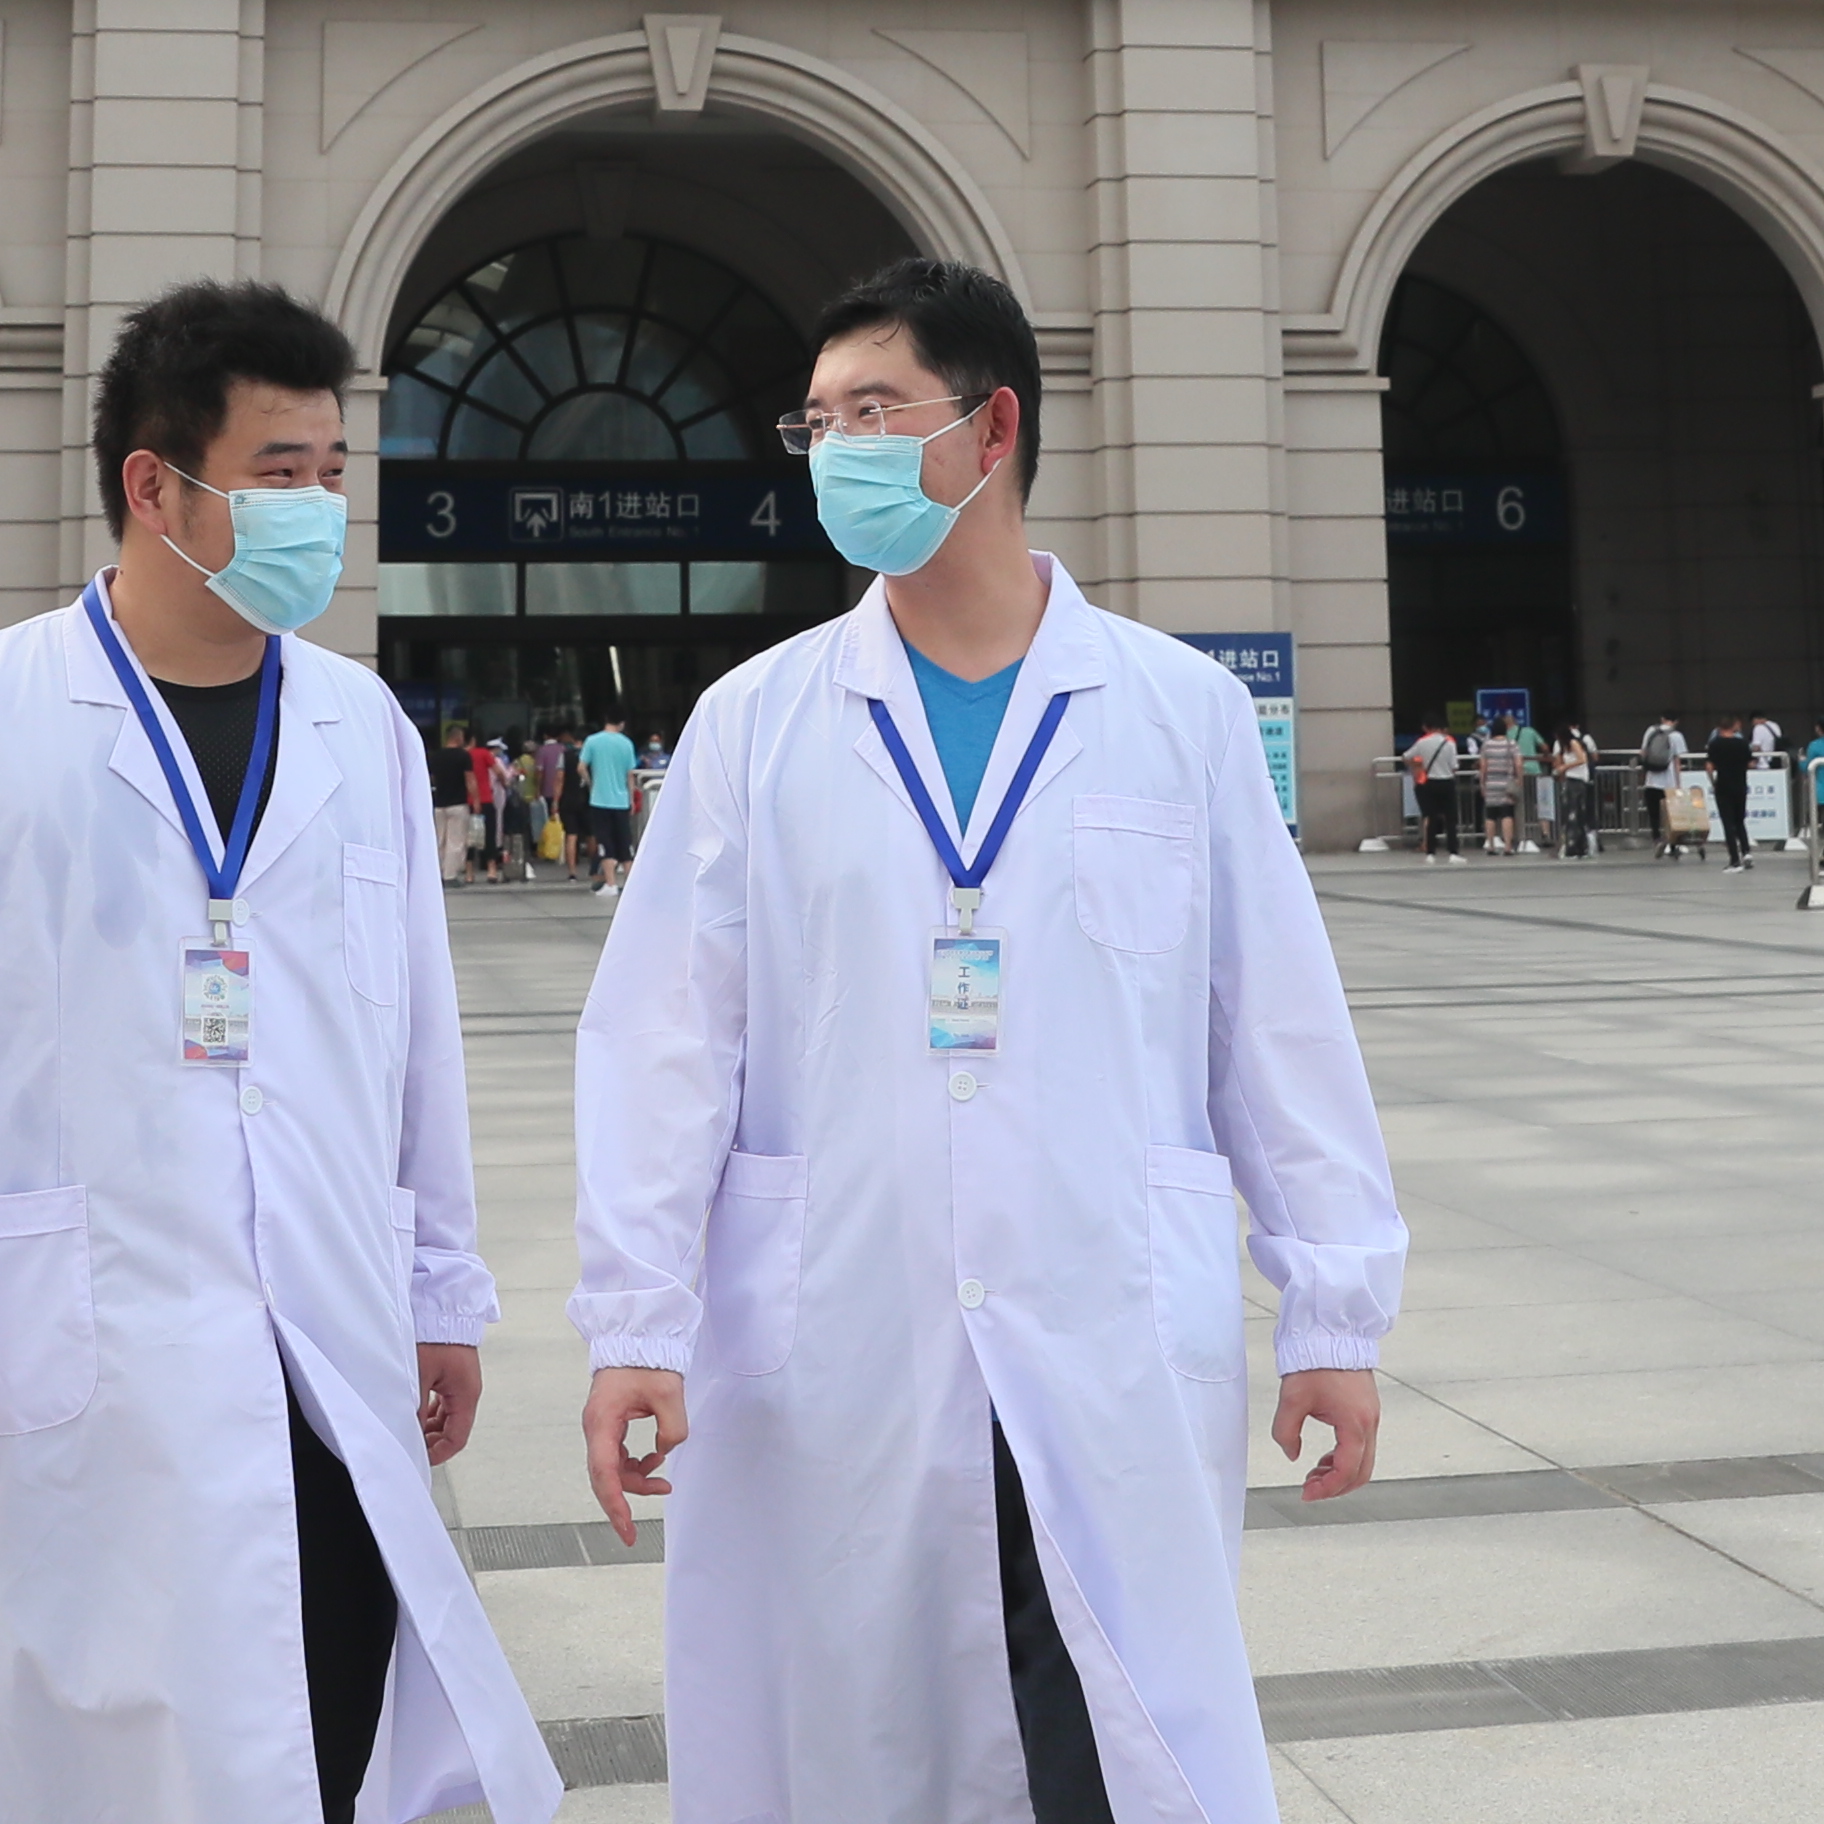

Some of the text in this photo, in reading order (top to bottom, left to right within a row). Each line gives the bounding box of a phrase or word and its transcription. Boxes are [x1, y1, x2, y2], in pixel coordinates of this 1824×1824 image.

[426, 491, 456, 537] 3
[569, 490, 699, 519] 南1进站口
[750, 490, 781, 537] 4
[1497, 484, 1526, 530] 6
